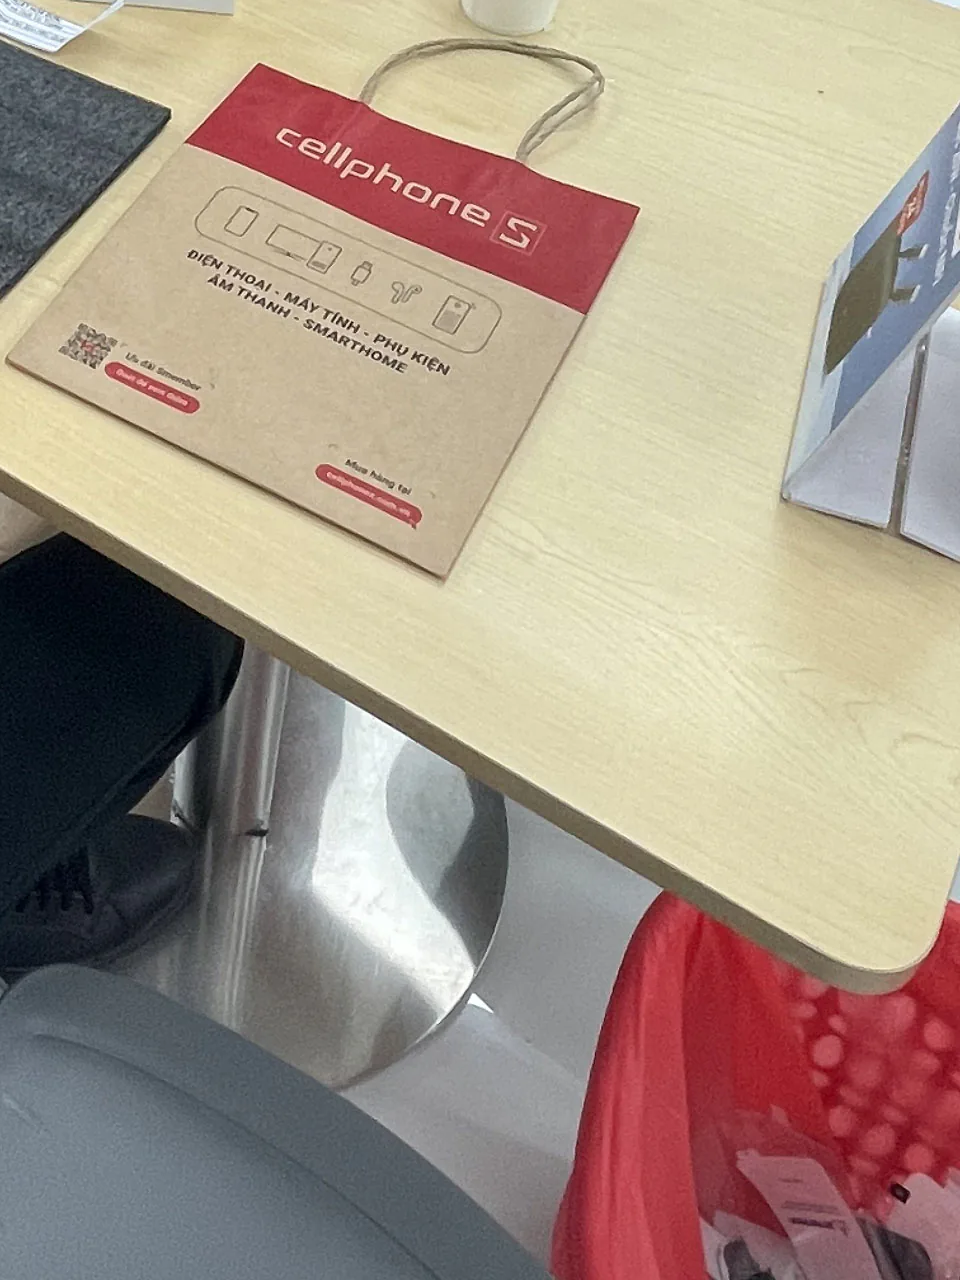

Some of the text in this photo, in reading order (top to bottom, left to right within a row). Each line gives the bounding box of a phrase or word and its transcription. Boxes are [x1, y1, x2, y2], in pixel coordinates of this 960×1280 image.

[187, 248, 223, 270] ĐIỆN
[225, 263, 272, 293] THOẠI
[284, 291, 320, 313] MÁY
[322, 306, 362, 335] TÍNH
[373, 333, 408, 357] PHỤ
[411, 349, 451, 376] KIỆN
[207, 273, 235, 294] ÂM
[236, 286, 292, 319] THANH
[303, 318, 409, 374] SMARTHOME
